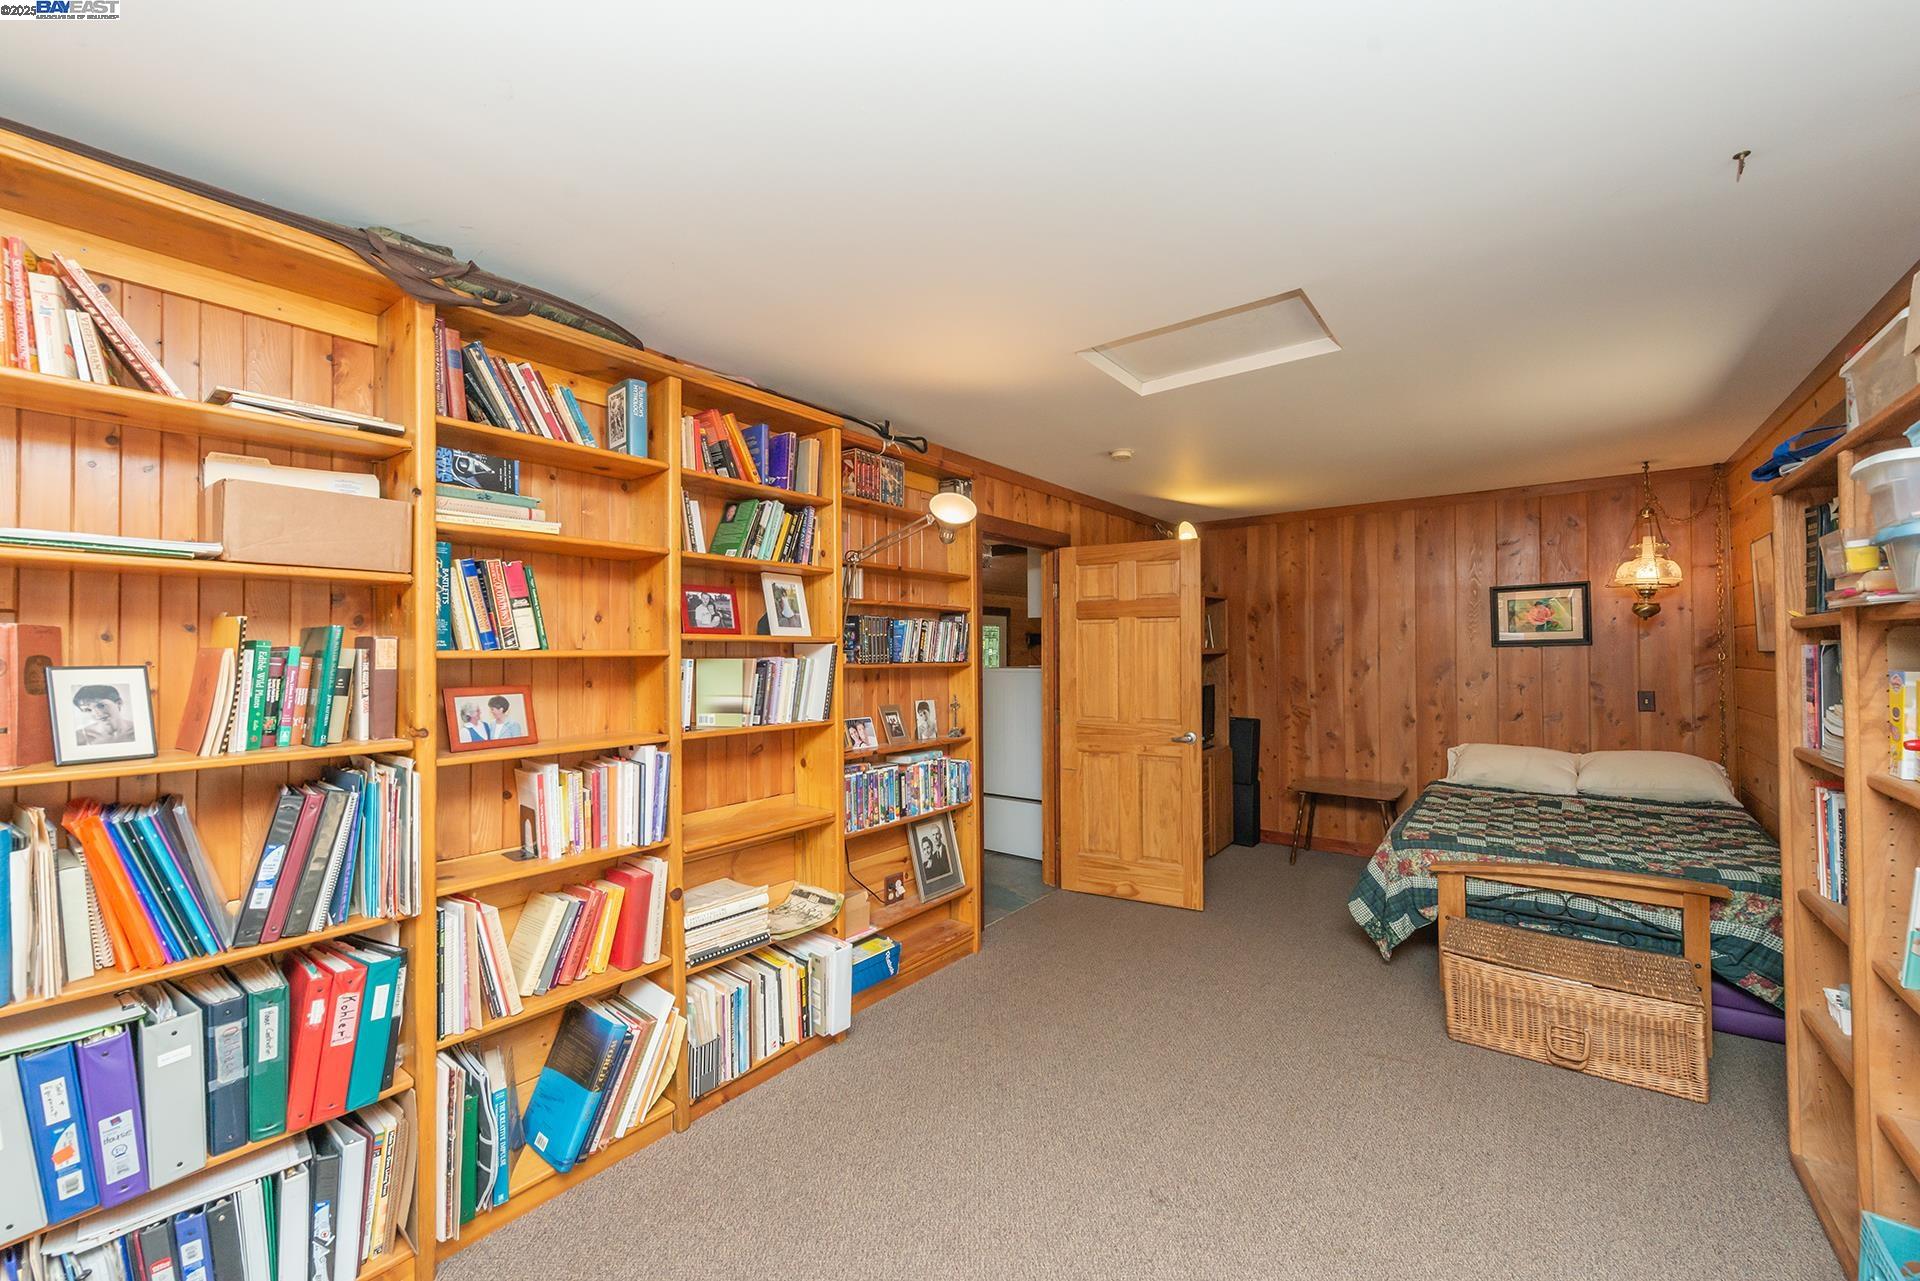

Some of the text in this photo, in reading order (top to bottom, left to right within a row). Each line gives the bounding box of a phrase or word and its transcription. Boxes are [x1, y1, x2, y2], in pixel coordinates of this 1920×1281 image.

[256, 650, 267, 672] Edible
[255, 671, 265, 688] Wild
[253, 689, 264, 709] Plants
[338, 995, 356, 1036] Kohler
[599, 1040, 618, 1082] WORLD
